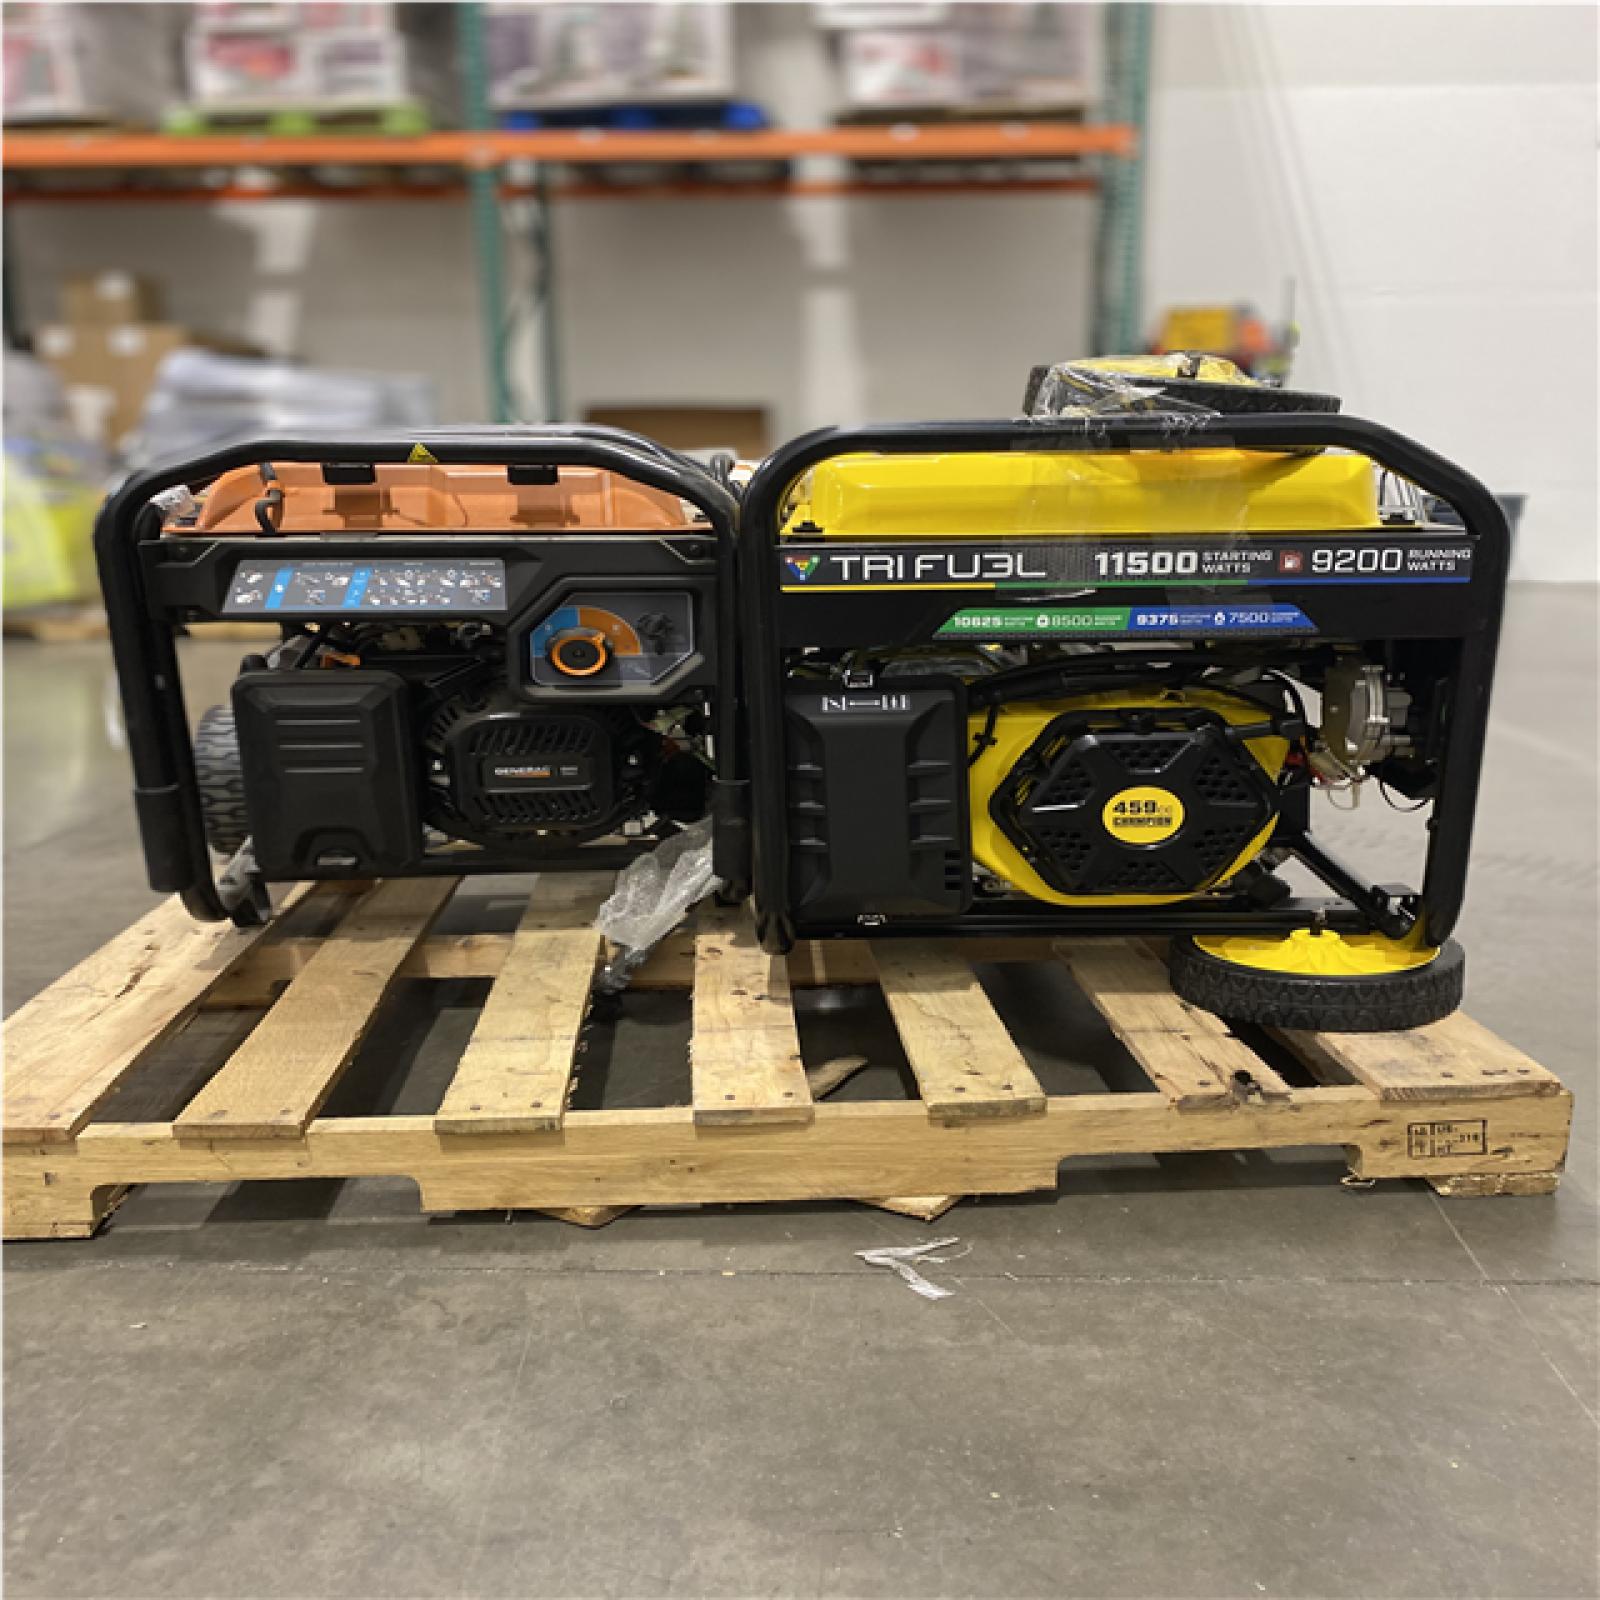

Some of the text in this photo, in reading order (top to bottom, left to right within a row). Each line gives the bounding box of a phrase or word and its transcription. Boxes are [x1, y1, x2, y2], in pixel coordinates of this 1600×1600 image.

[1202, 550, 1273, 561] STARTING
[1311, 548, 1402, 573] 9200
[829, 554, 904, 581] TRI
[1094, 551, 1199, 576] 11500
[1202, 562, 1251, 574] WATTS
[1407, 560, 1456, 572] WATTS
[1229, 611, 1270, 625] 7500
